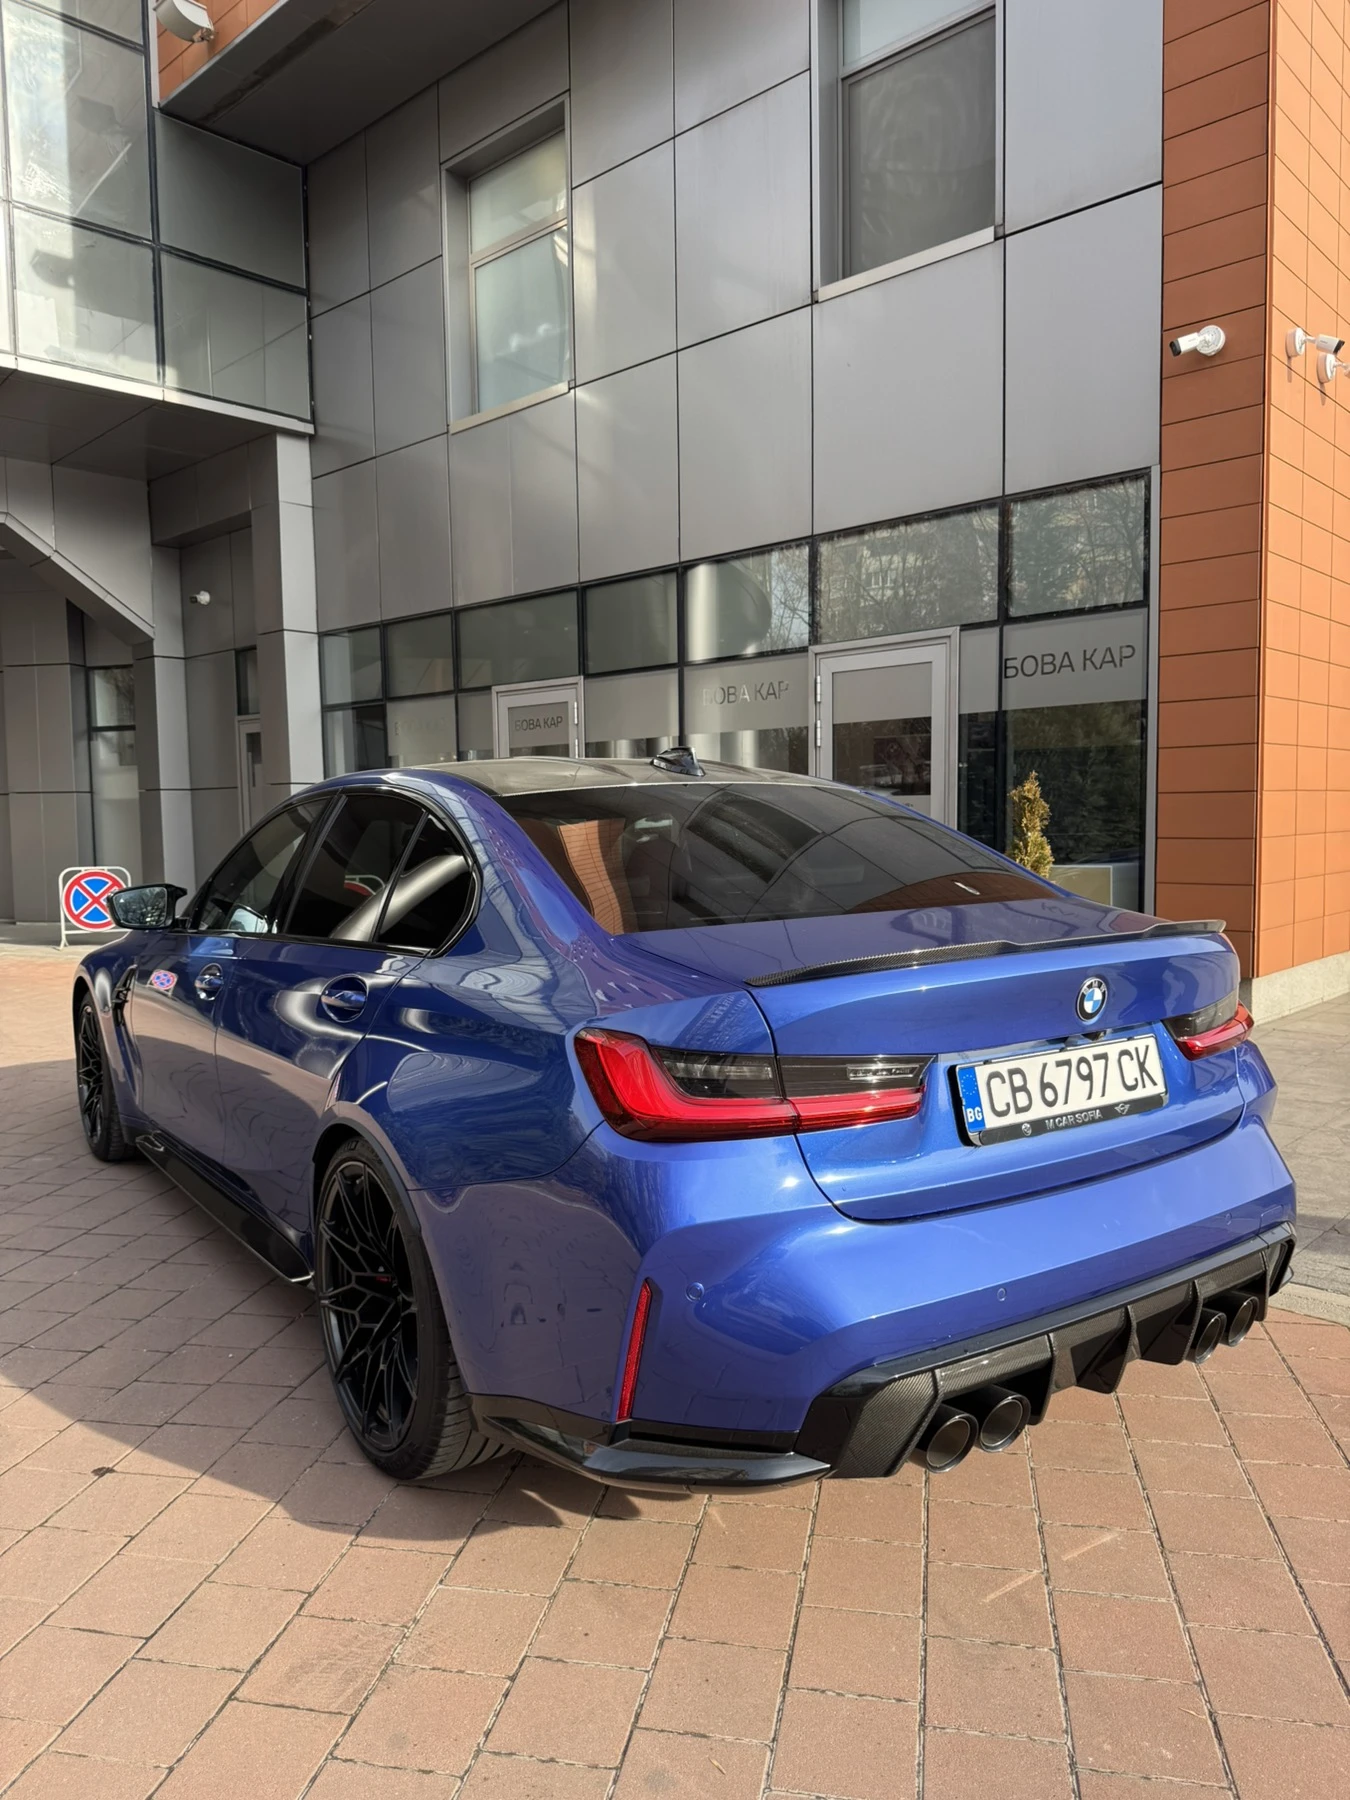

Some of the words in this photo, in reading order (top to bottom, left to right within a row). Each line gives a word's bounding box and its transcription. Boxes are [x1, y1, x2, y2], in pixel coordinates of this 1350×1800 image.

[1003, 651, 1075, 679] БОВА
[1083, 645, 1136, 671] КАР
[754, 680, 789, 701] КАР
[543, 715, 563, 729] КАР
[986, 1066, 1033, 1118] CB
[1039, 1052, 1109, 1108] 6797
[1117, 1044, 1158, 1092] CK
[966, 1107, 983, 1122] BG
[1055, 1115, 1075, 1127] CAR
[1075, 1109, 1103, 1123] SOFIA
